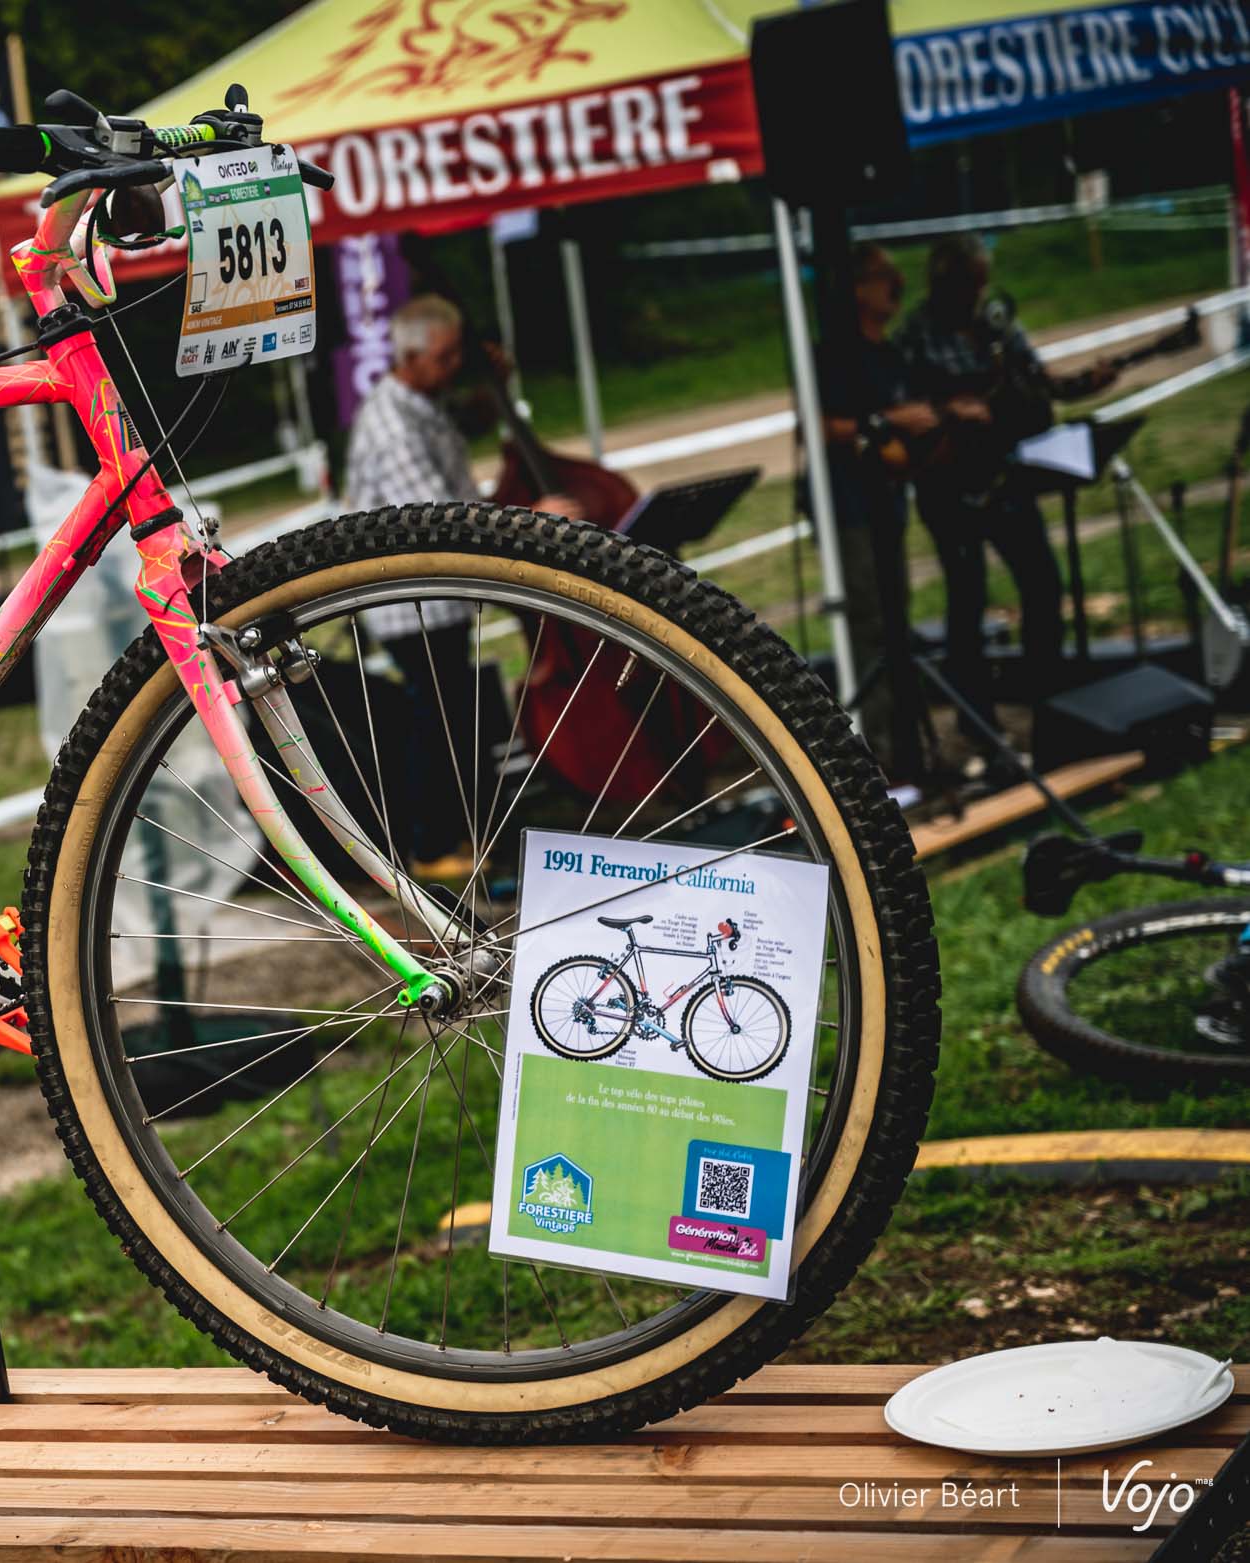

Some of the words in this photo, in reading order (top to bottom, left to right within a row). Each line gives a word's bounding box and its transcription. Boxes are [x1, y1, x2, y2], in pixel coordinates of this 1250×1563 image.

[896, 11, 1152, 123] ORESTIERE
[297, 75, 713, 226] FORESTIERE
[218, 161, 248, 179] OKTEO
[218, 218, 287, 284] 5813
[543, 850, 584, 873] 1991
[590, 854, 668, 883] Ferraroli
[675, 865, 755, 895] California
[599, 1083, 610, 1095] Le
[611, 1086, 623, 1098] top
[645, 1090, 658, 1101] des
[566, 1093, 576, 1103] de
[578, 1094, 586, 1104] la
[588, 1095, 599, 1106] fin
[601, 1098, 615, 1109] des
[671, 1107, 694, 1121] début
[518, 1202, 592, 1223] FORESTIERE
[535, 1218, 575, 1232] Vintage
[676, 1224, 735, 1242] Génération
[738, 1241, 758, 1257] Bike
